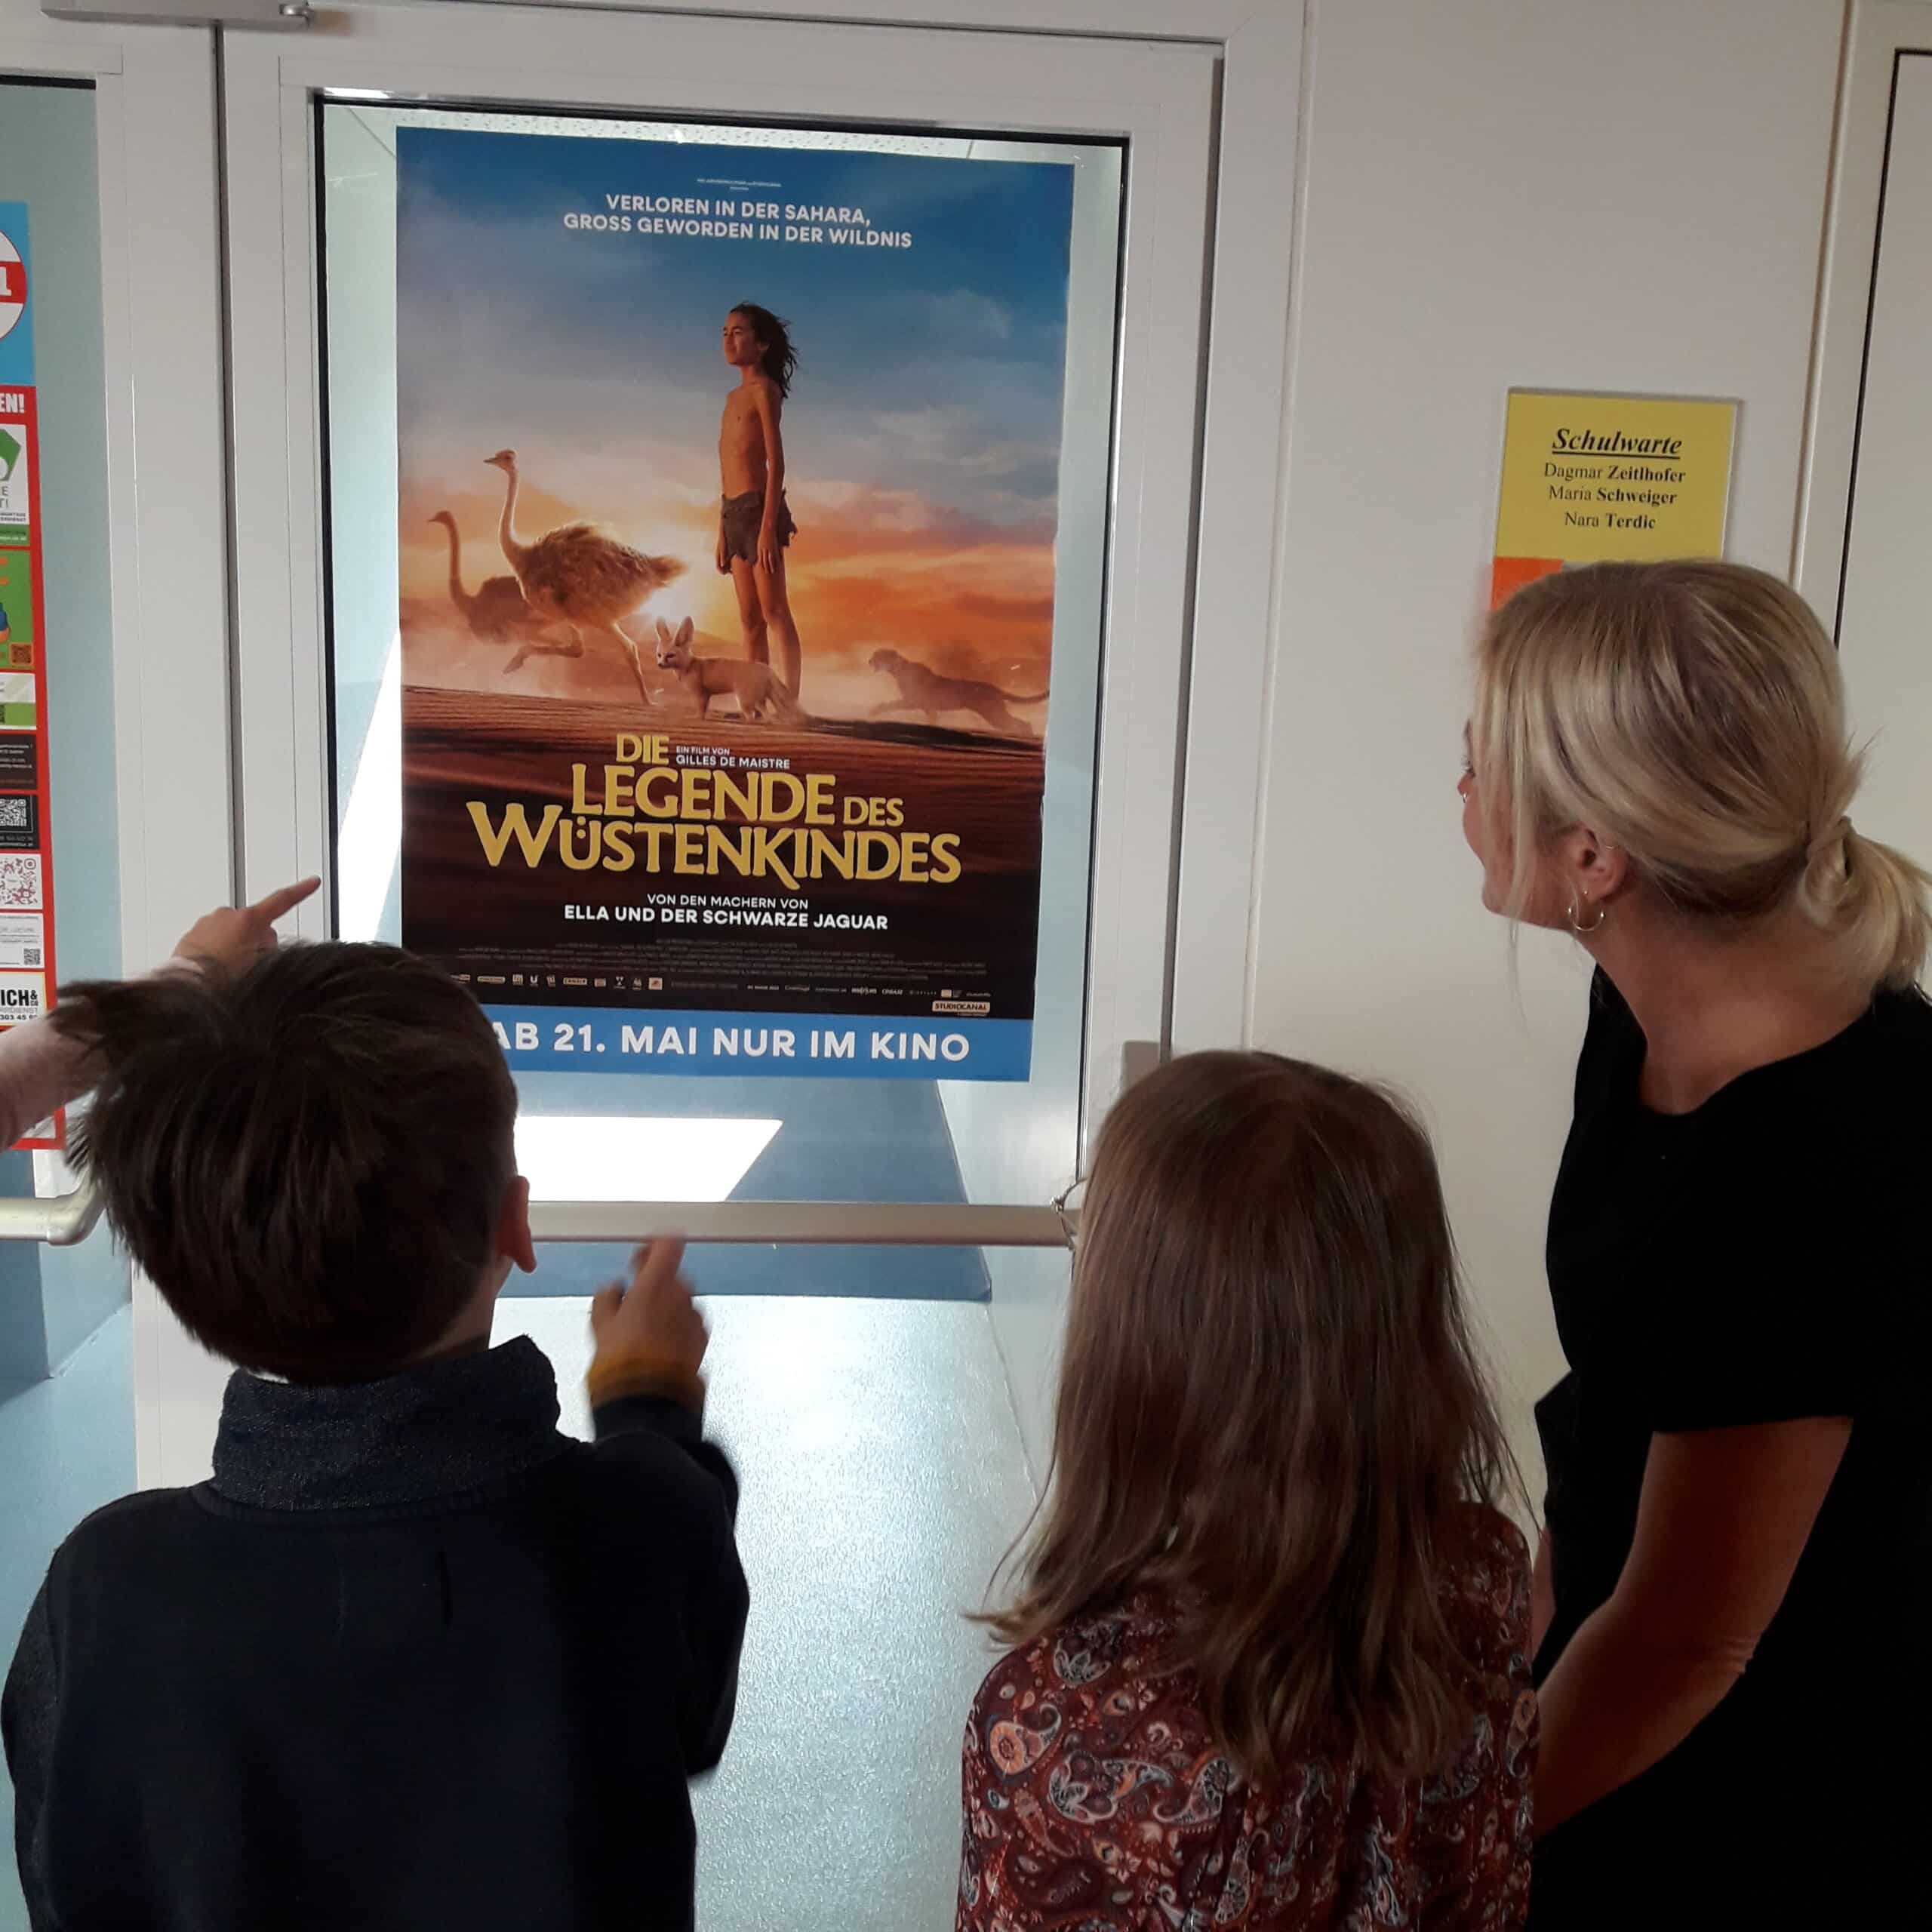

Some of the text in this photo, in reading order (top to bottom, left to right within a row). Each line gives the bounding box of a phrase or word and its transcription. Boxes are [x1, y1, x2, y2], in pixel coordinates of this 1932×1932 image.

[606, 194, 871, 228] VERLOREN IN DER SAHARA,
[563, 213, 912, 248] GROSS GEWORDEN IN DER WILDNIS
[1552, 428, 1682, 454] Schulwarte
[1544, 463, 1686, 483] Dagmar Zeitlhofer
[1549, 485, 1678, 508] Maria Schweiger
[1564, 512, 1656, 530] Nara Terdic
[615, 733, 669, 764] DIE
[675, 746, 731, 755] EIN FILM VON
[675, 755, 791, 769] GILLES DE MAISTRE
[571, 763, 904, 826] LEGENDE DES
[466, 801, 961, 891] WÜSTENKINDES
[647, 893, 809, 909] VON DEN MACHERN VON
[564, 905, 889, 930] ELLA UND DER SCHWARZE JAGUAR
[934, 1003, 987, 1011] STUDIOCANAL
[554, 1023, 605, 1052] 21.
[622, 1026, 697, 1055] MAI
[713, 1029, 795, 1057] NUR
[811, 1032, 856, 1059] IM
[871, 1032, 971, 1062] KINO
